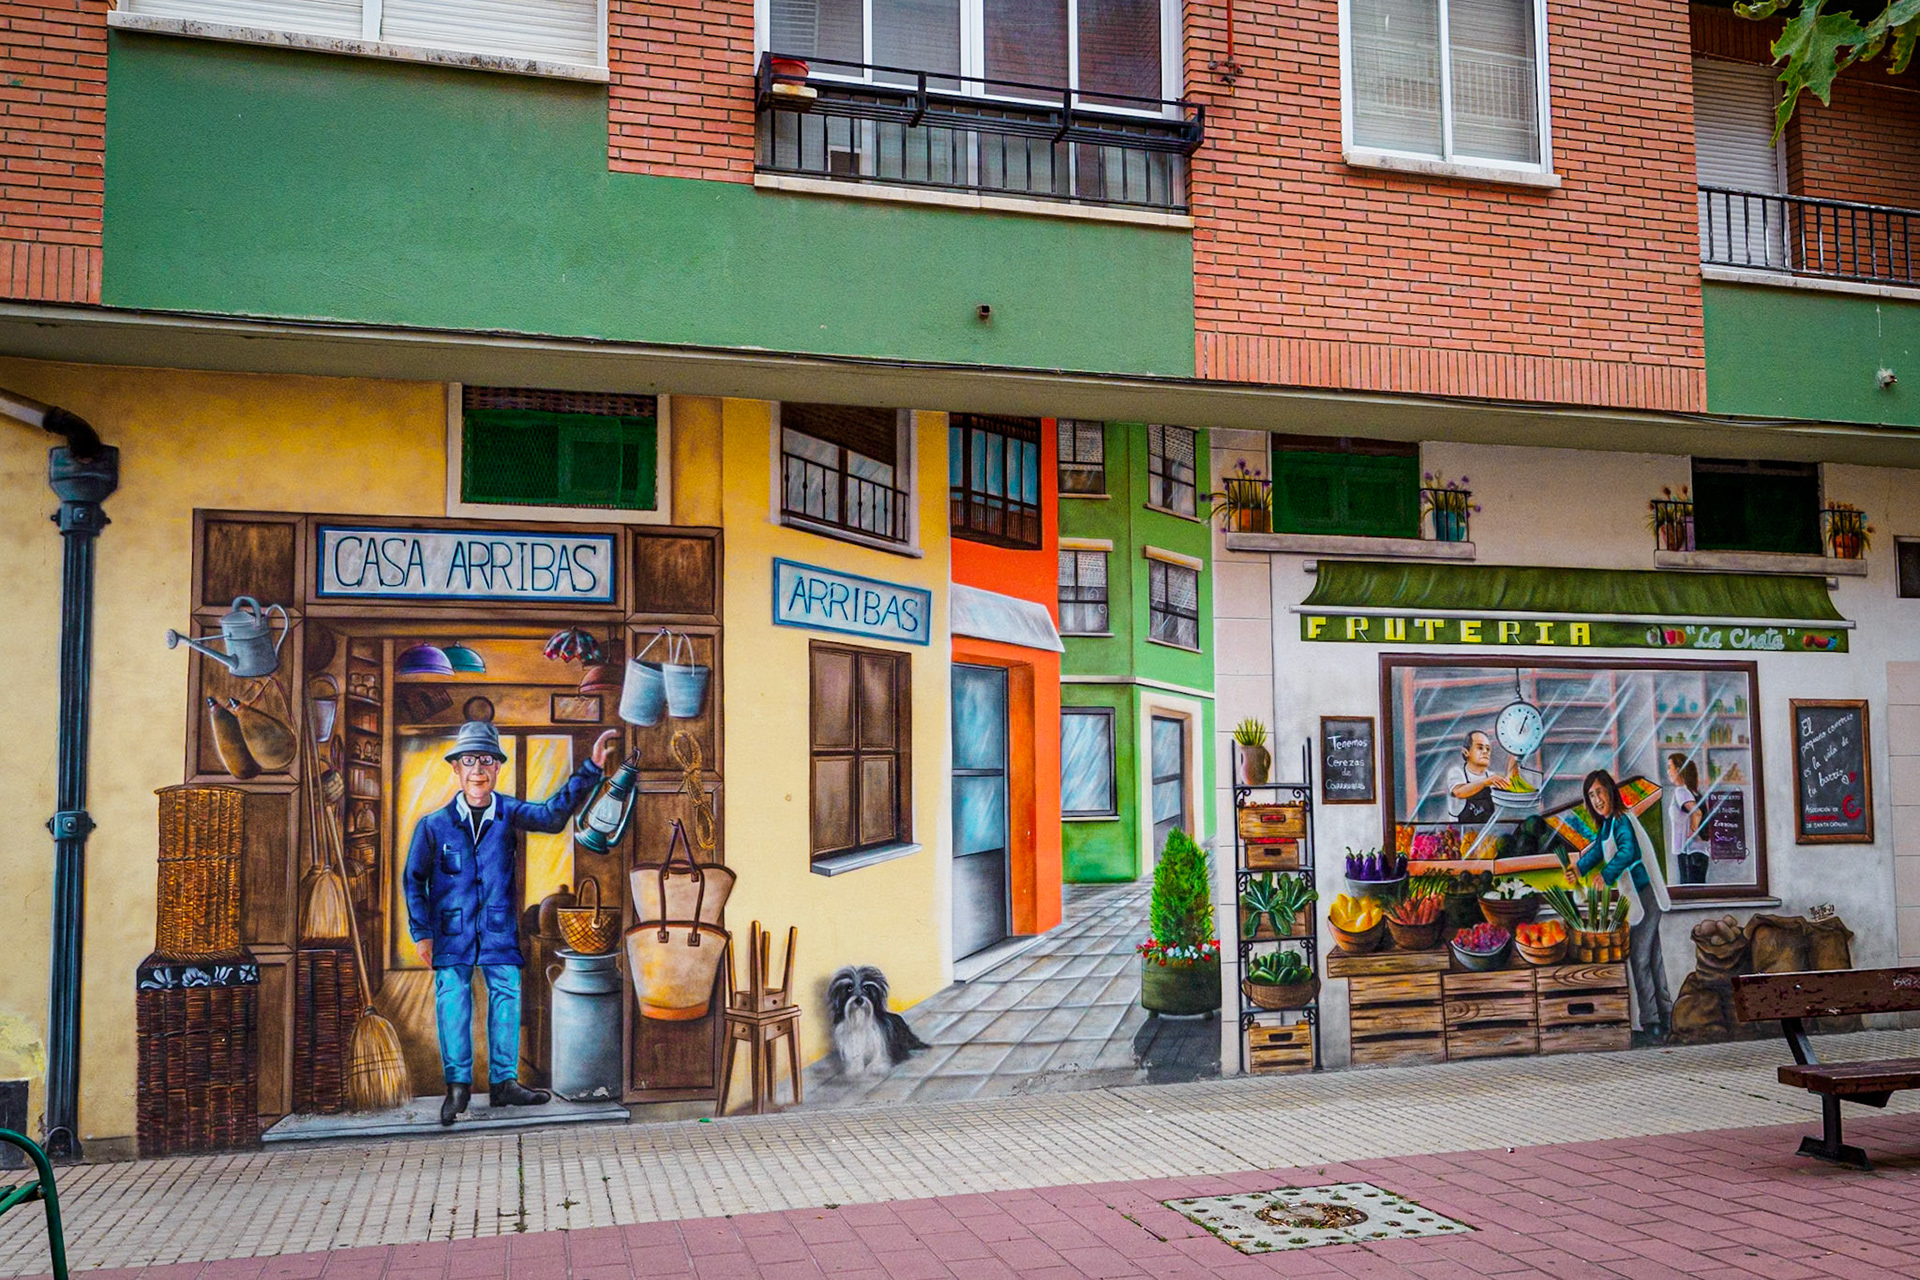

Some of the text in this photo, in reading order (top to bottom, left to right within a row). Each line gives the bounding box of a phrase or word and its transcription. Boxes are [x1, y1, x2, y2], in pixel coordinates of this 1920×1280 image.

[334, 536, 597, 592] CASA ARRIBAS
[788, 576, 919, 632] ARRIBAS
[1307, 616, 1591, 646] FRUTERIA
[1801, 716, 1814, 737] El
[1327, 735, 1368, 750] Tenemos
[1326, 754, 1365, 767] Cerezas
